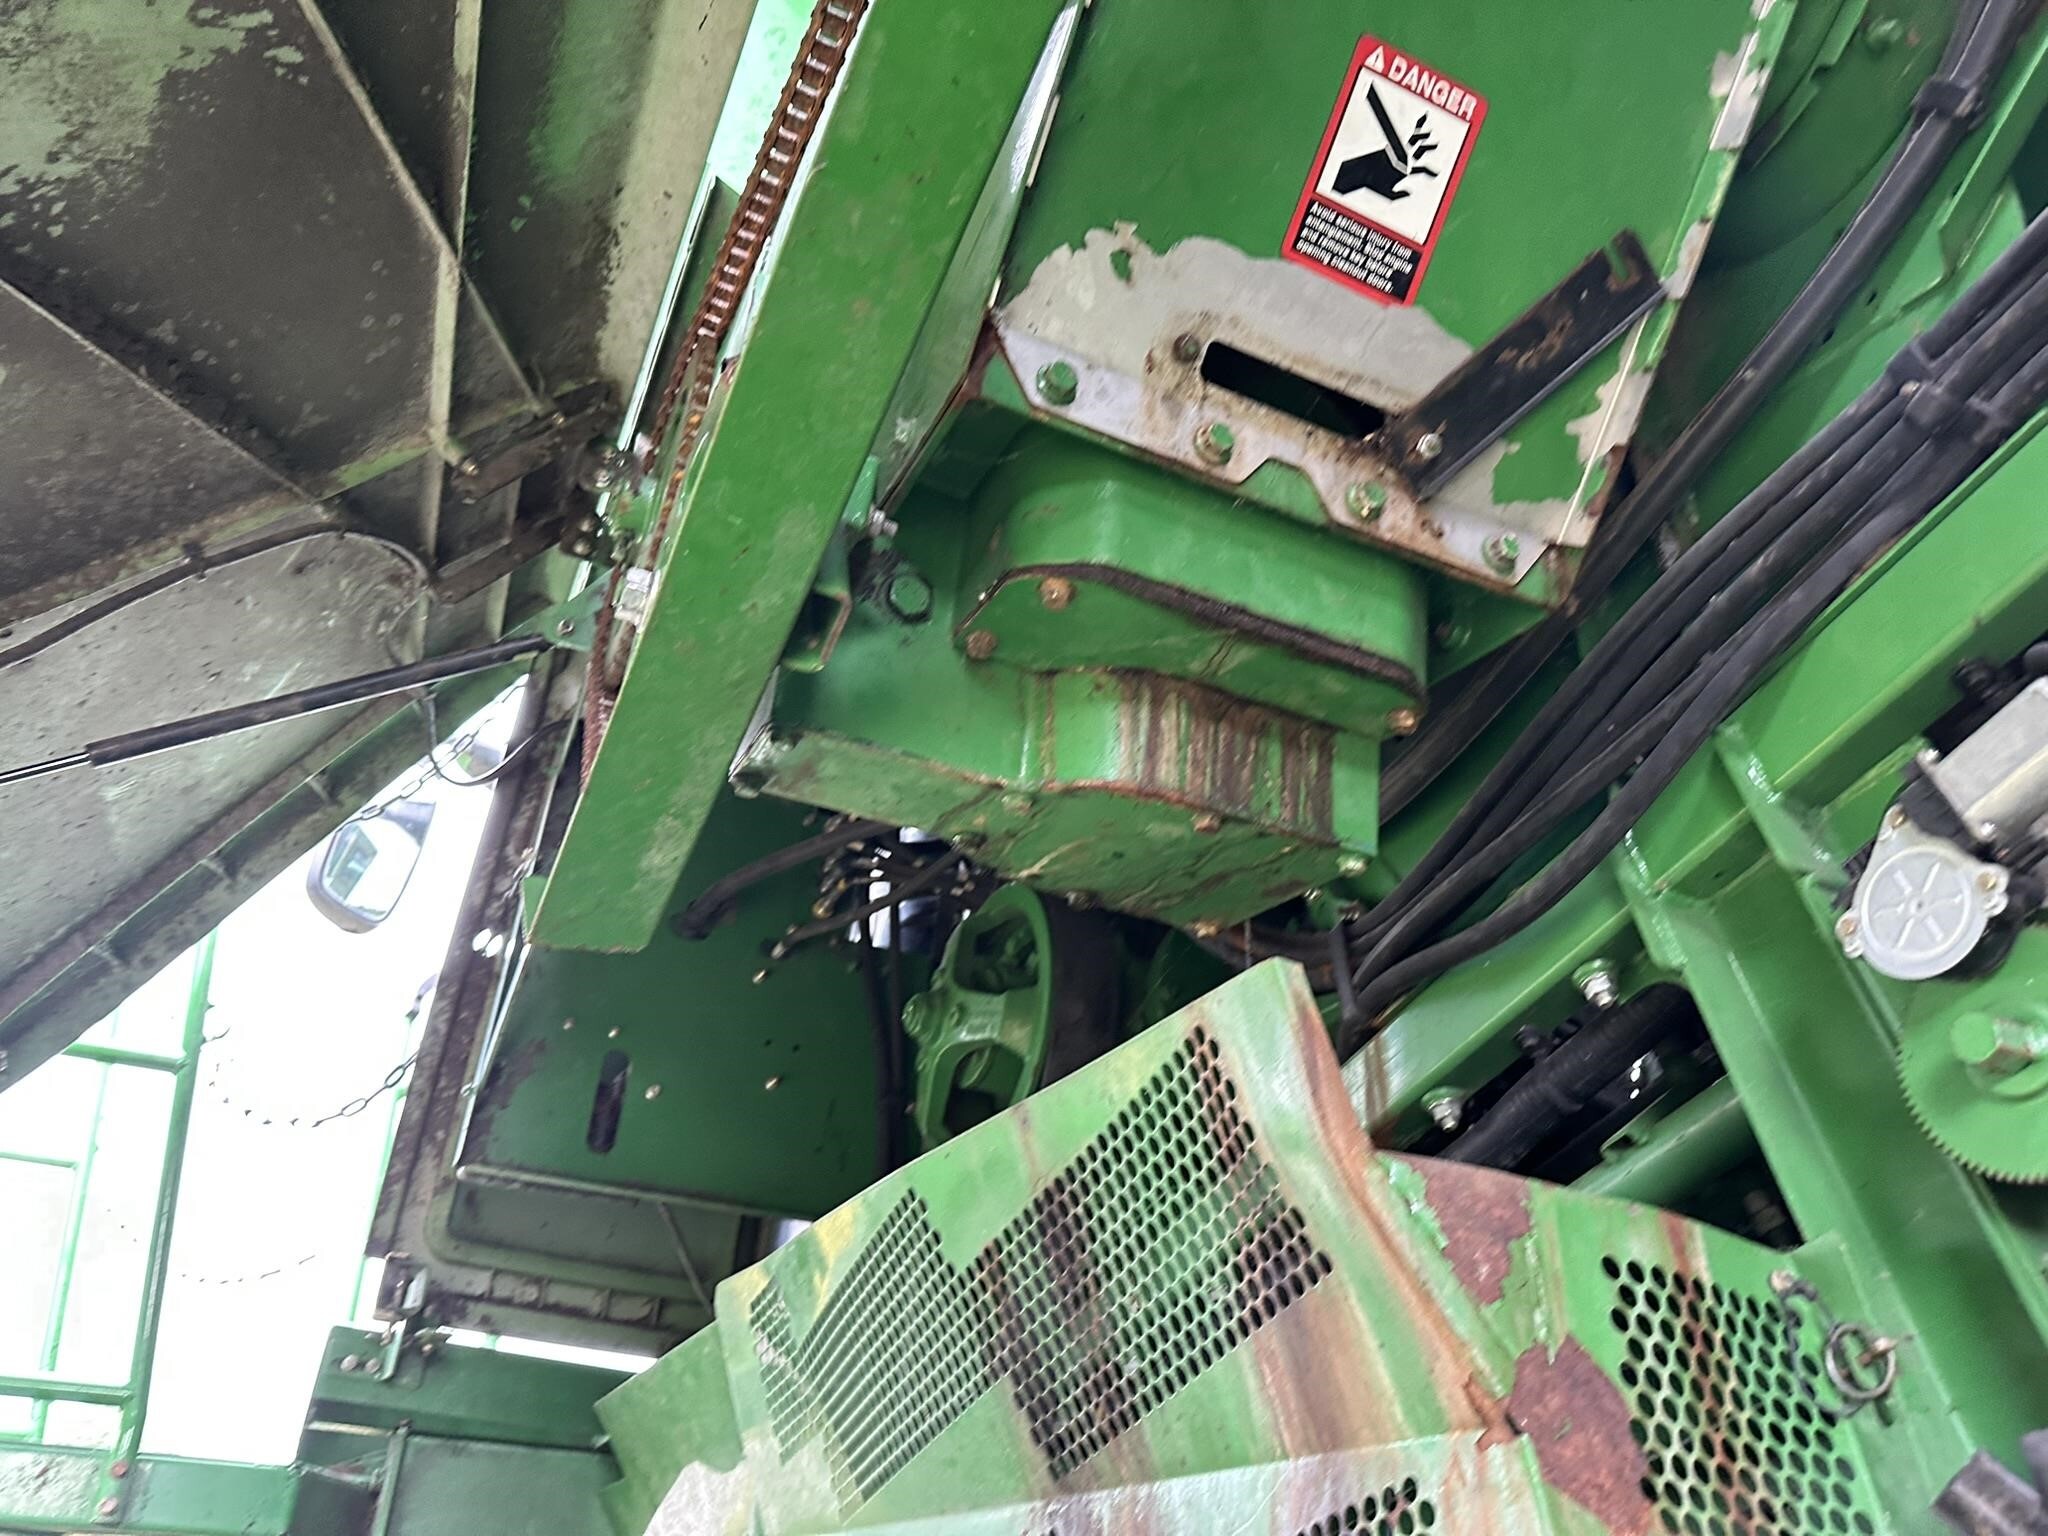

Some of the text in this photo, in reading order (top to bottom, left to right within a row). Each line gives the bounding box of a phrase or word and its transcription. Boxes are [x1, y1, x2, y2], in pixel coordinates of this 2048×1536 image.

[1387, 54, 1477, 121] DANGER
[1300, 227, 1394, 279] and remove key before
[1309, 200, 1413, 260] Avoid serious injury from
[1296, 238, 1333, 266] opening
[1330, 255, 1369, 281] cleanout
[1383, 252, 1413, 275] engine
